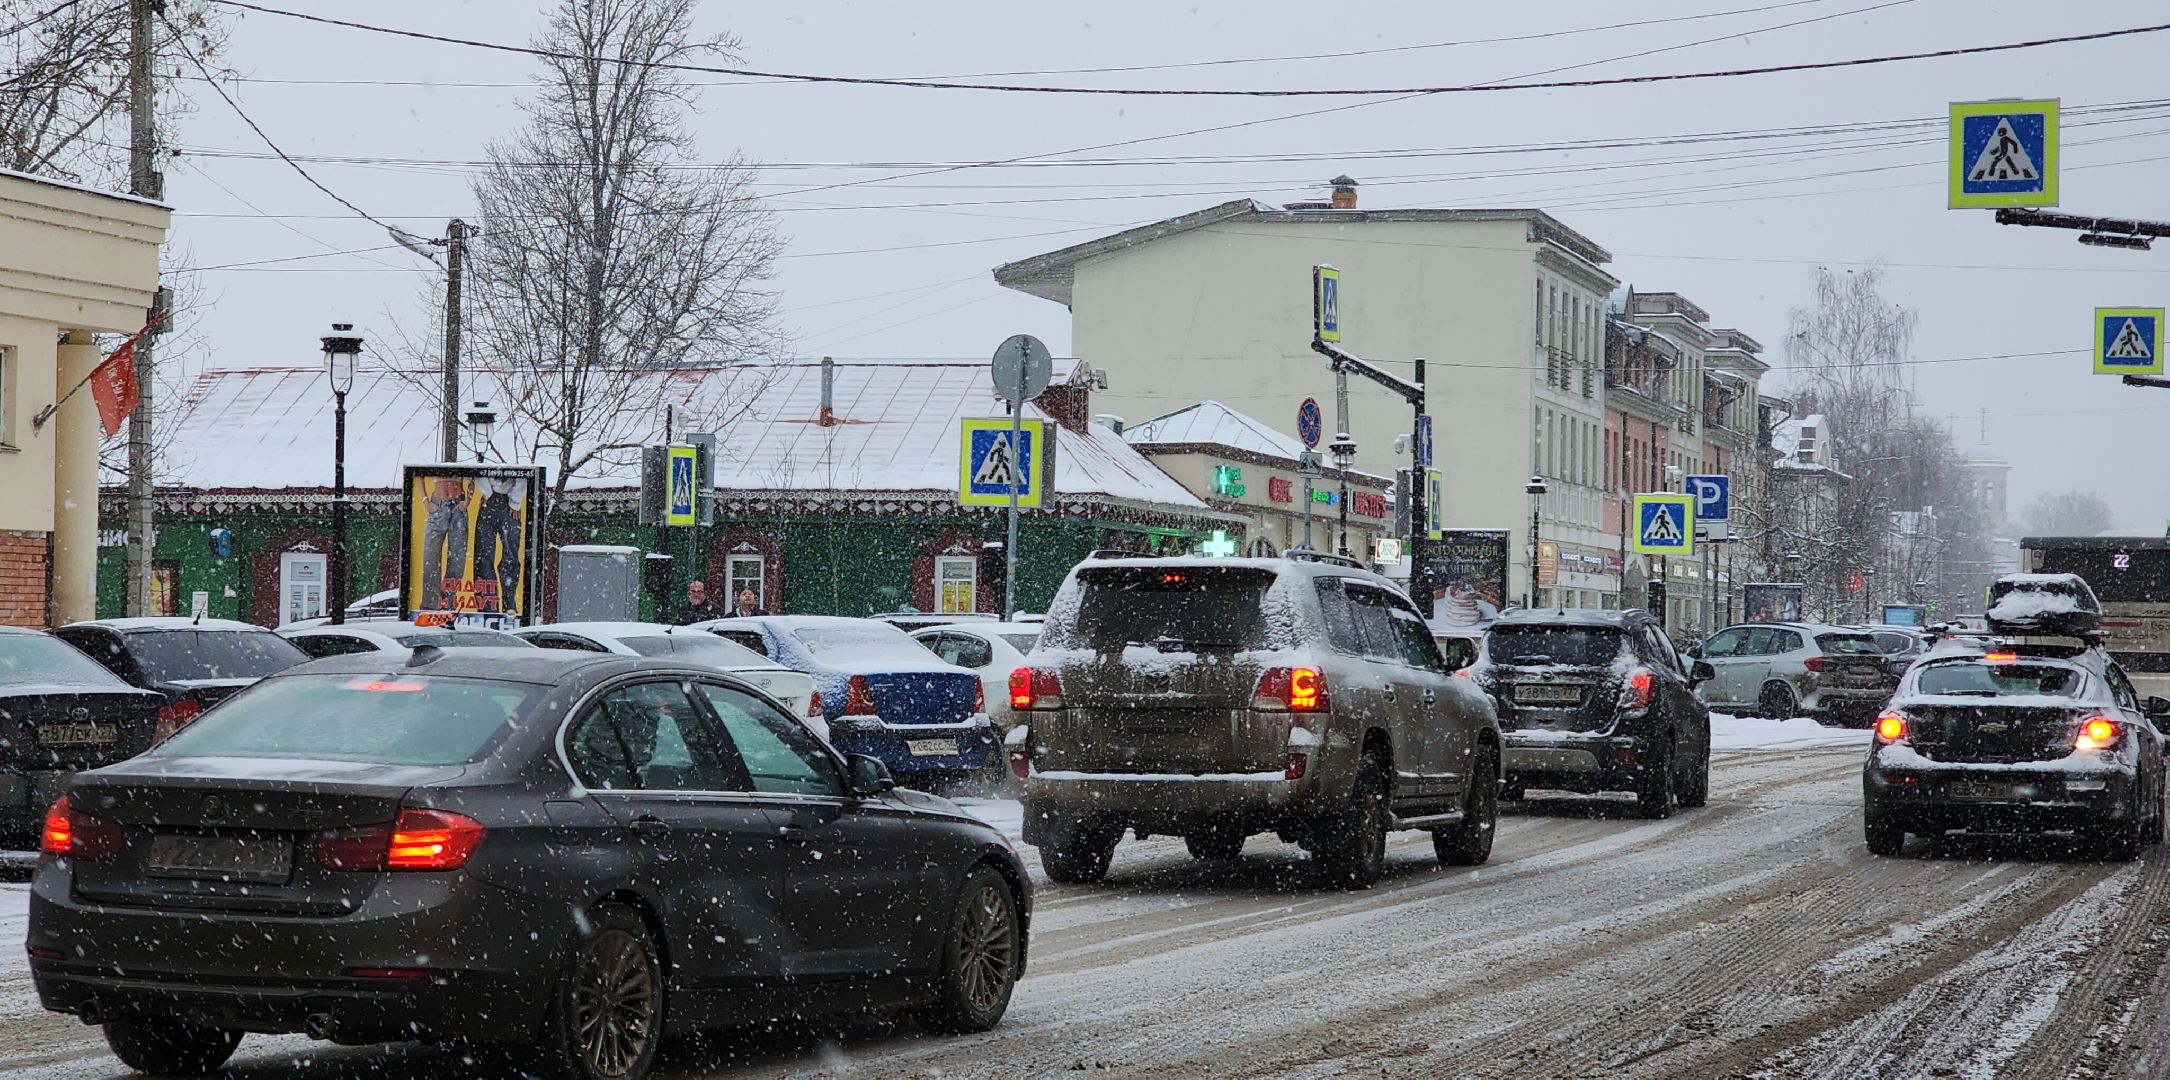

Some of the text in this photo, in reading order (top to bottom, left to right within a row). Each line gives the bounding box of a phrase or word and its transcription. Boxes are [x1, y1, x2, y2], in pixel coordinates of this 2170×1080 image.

[2113, 554, 2130, 568] 22
[441, 577, 499, 594] СИДЯТ
[453, 596, 499, 610] ИДУТ
